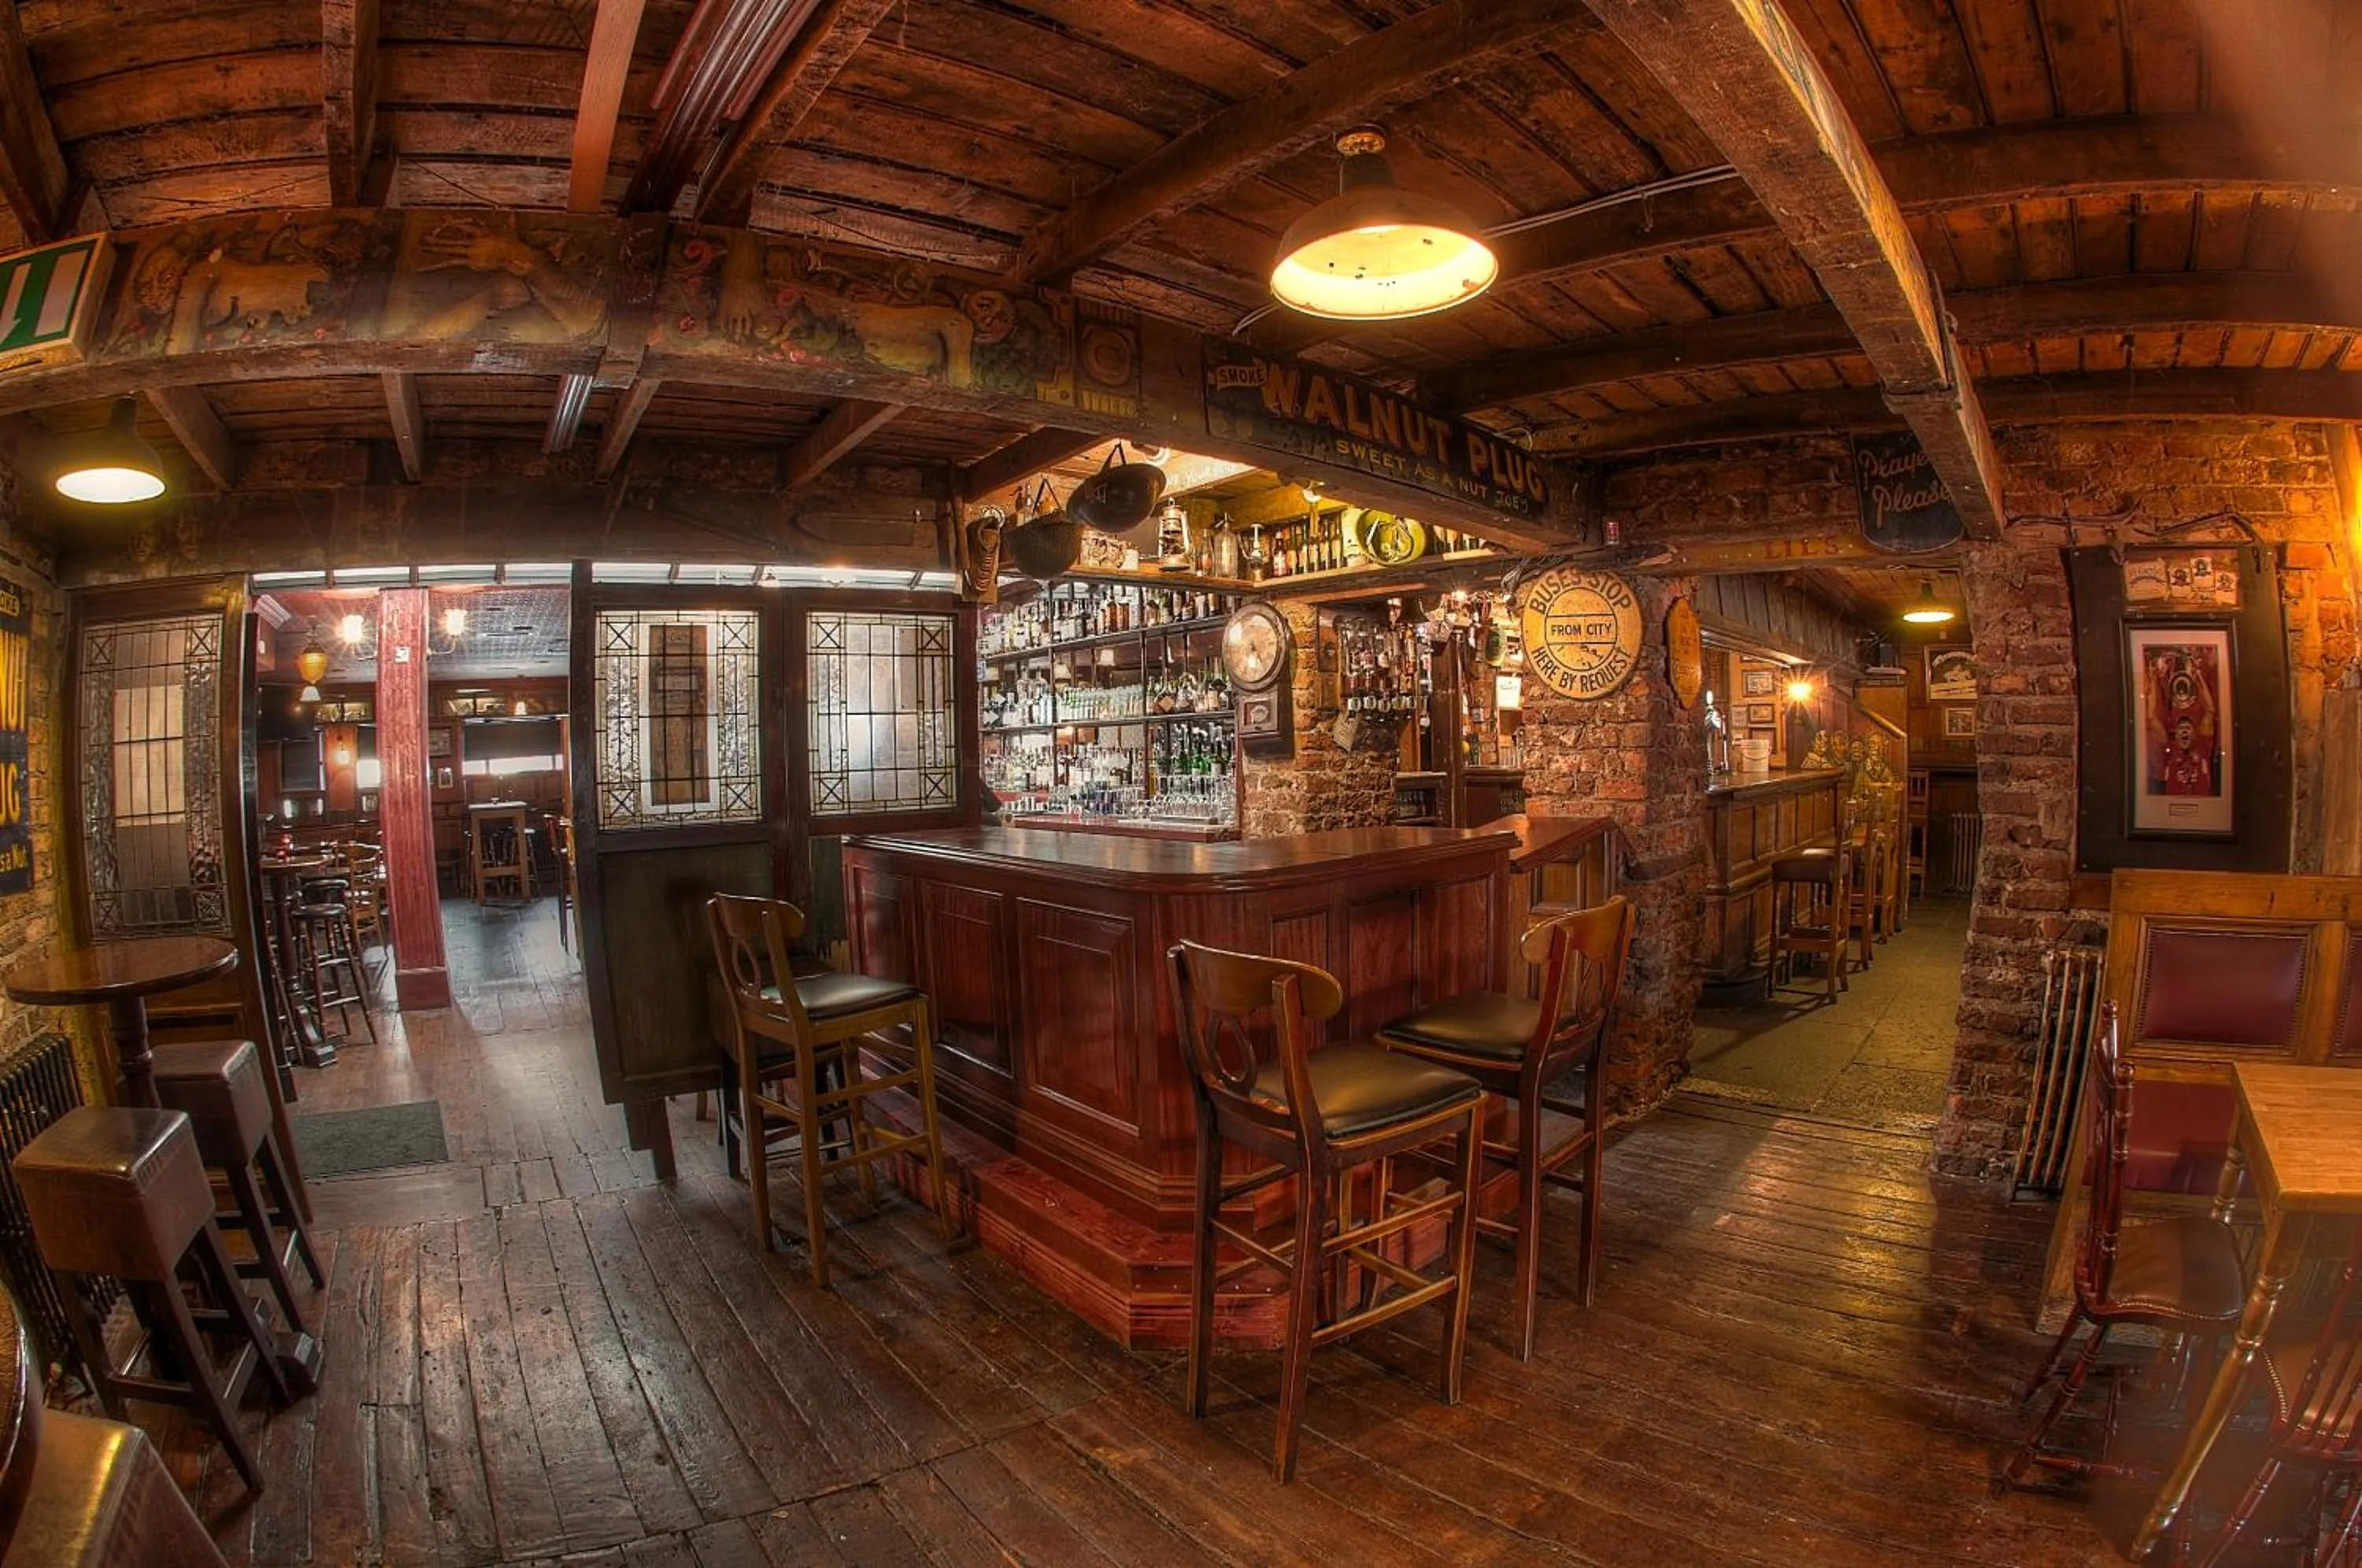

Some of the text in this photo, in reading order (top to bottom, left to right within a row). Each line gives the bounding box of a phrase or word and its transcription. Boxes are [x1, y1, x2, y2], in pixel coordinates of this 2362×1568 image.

[1219, 368, 1264, 384] SMOKE
[1253, 357, 1543, 502] WALNUT PLUG
[1336, 440, 1407, 472] SWEET
[1414, 462, 1436, 481] AS
[1441, 472, 1453, 487] A
[1458, 477, 1488, 499] NUT
[1858, 450, 1928, 491] Praye
[1529, 566, 1632, 615] BUSES STOP
[1550, 622, 1612, 636] FROM CITY
[0, 629, 29, 733] NUT
[1531, 644, 1632, 694] HERE BY REQUEST
[0, 760, 20, 825] UG
